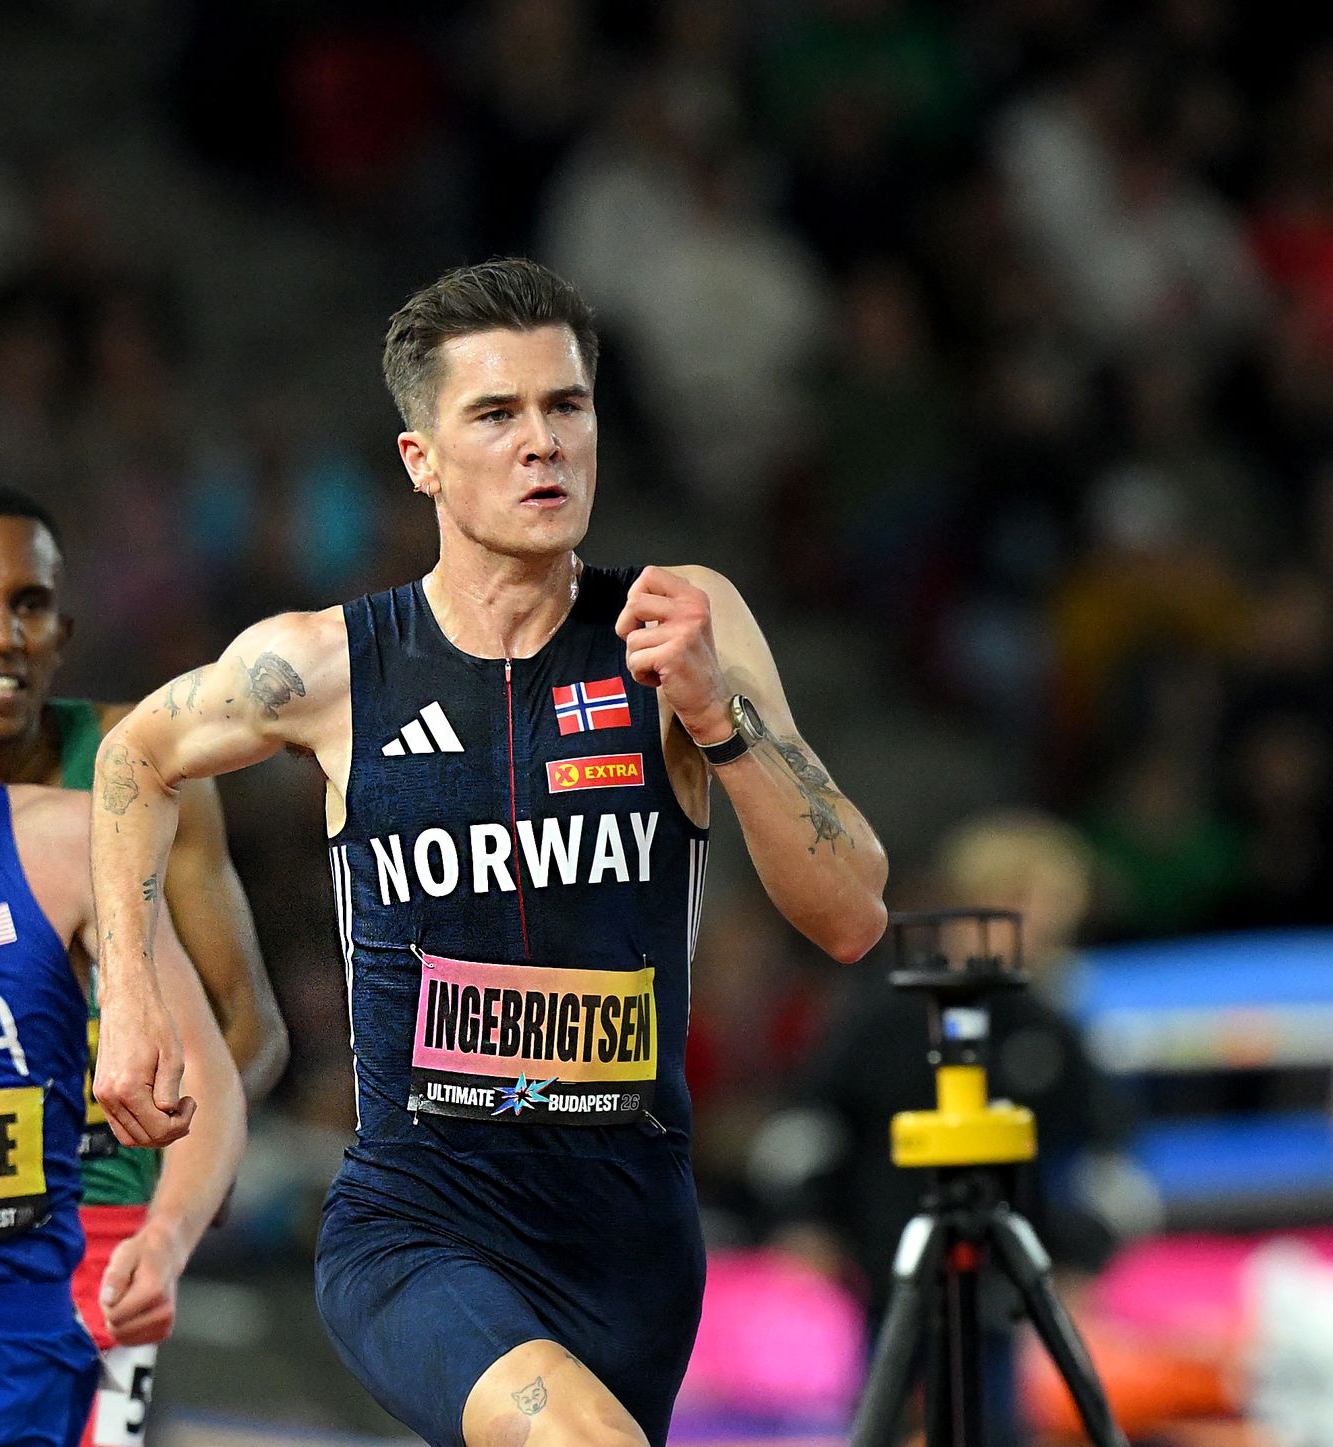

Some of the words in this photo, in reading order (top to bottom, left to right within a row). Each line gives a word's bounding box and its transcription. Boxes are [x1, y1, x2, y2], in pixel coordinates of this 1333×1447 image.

[585, 763, 638, 779] EXTRA
[370, 811, 659, 906] NORWAY
[424, 979, 650, 1063] INGEBRIGTSEN
[427, 1082, 495, 1108] ULTIMATE
[548, 1093, 621, 1113] BUDAPEST
[621, 1093, 641, 1112] 26
